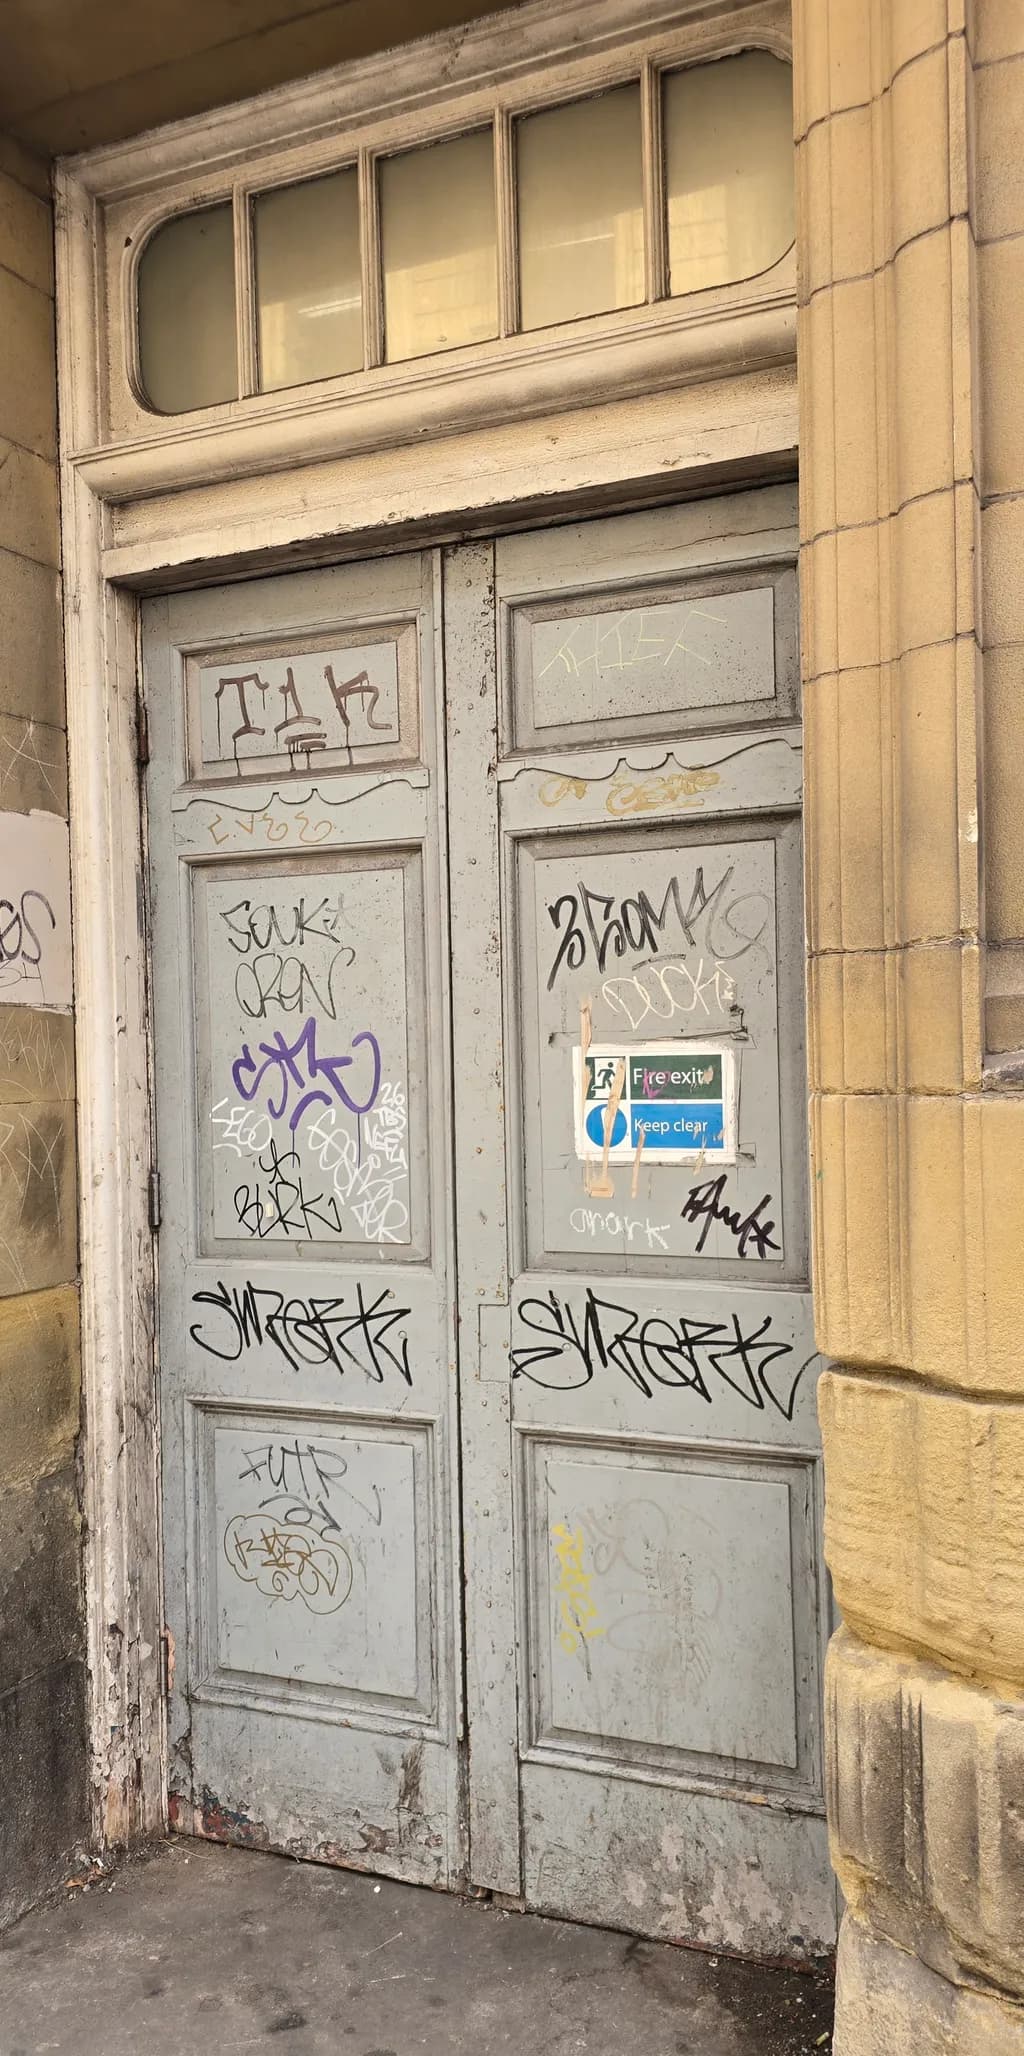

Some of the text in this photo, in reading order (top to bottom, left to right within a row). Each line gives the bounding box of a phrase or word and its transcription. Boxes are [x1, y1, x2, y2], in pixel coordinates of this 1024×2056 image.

[633, 1067, 666, 1085] Fire
[670, 1067, 704, 1085] exit
[634, 1117, 708, 1135] Keep clear
